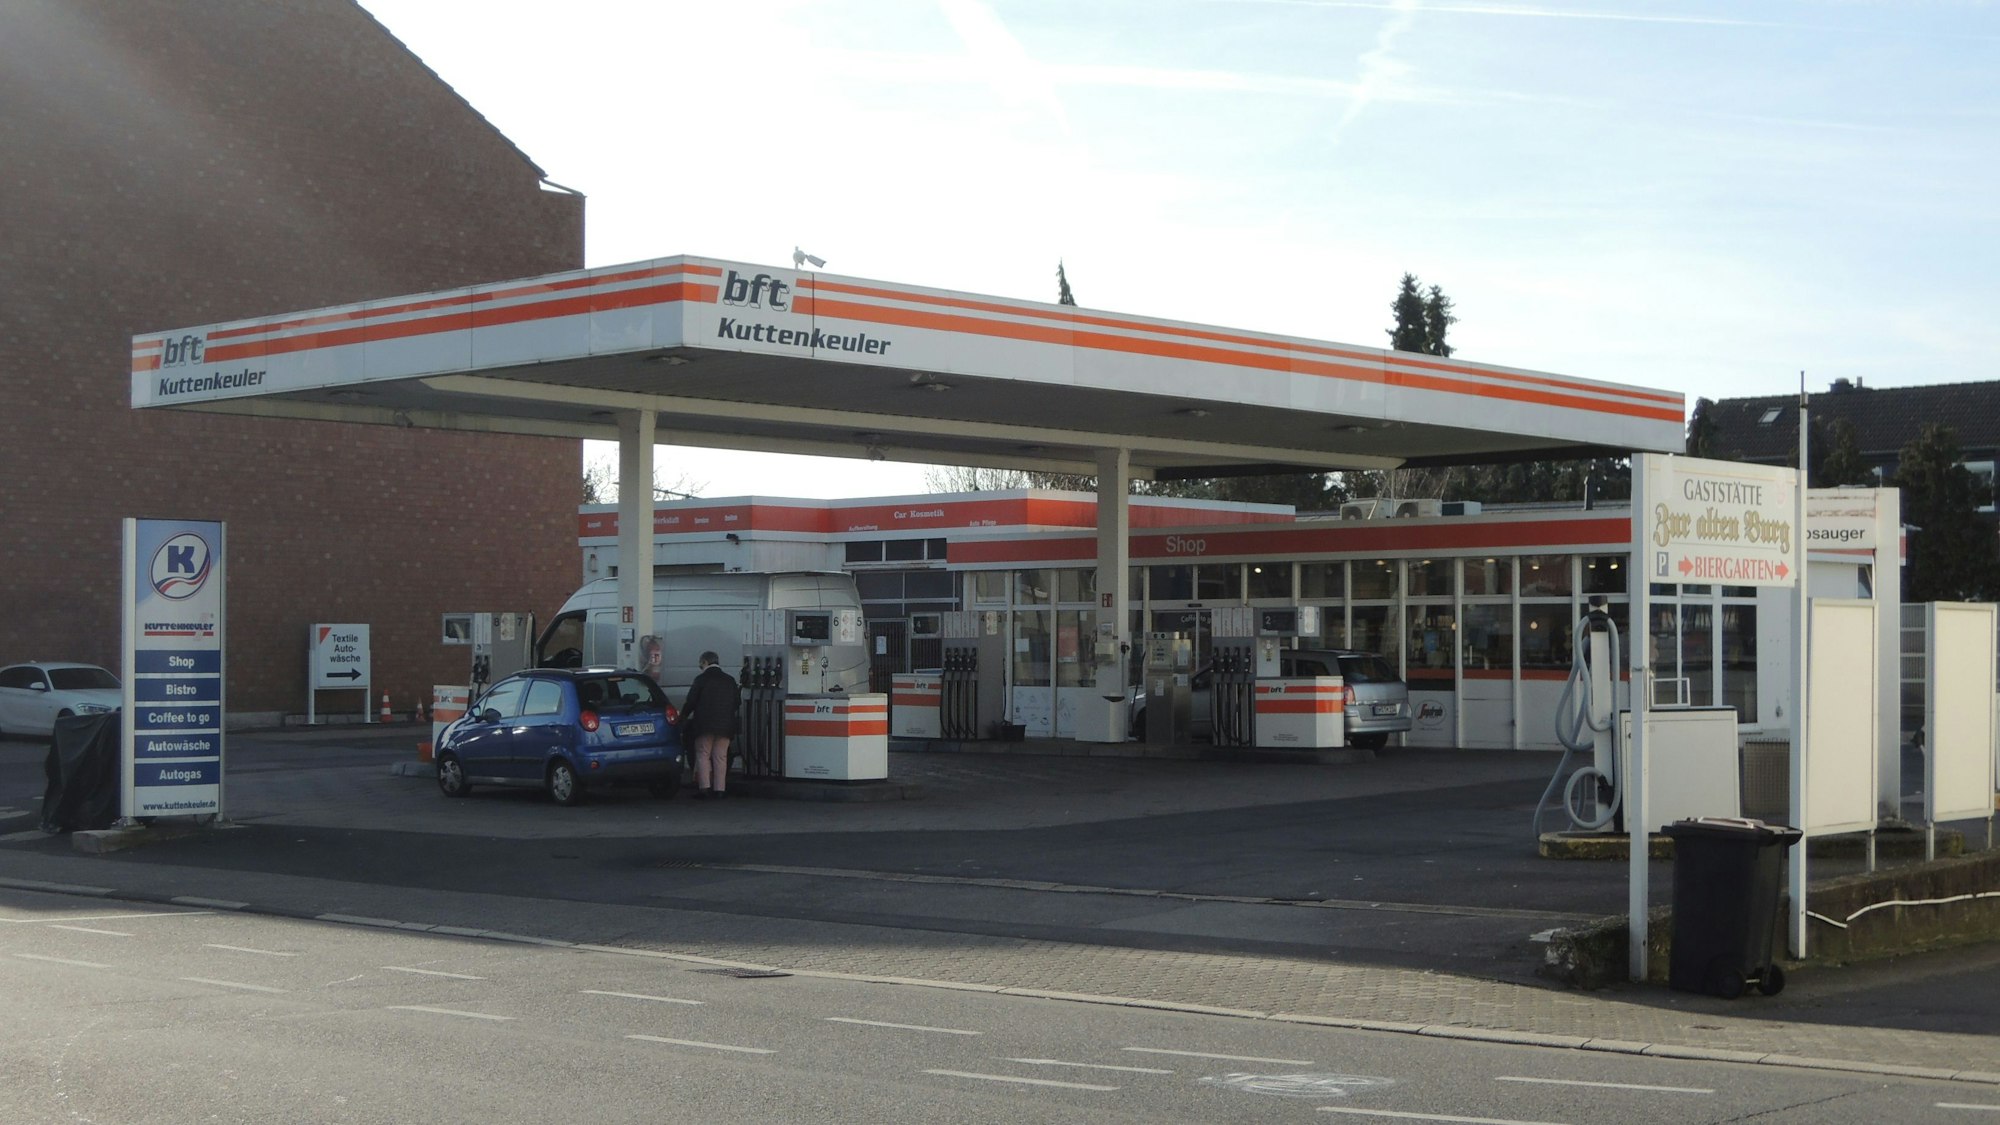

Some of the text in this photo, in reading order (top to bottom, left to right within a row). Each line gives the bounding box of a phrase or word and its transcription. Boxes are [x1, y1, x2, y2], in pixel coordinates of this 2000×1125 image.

[722, 270, 790, 312] bft
[717, 316, 892, 355] Kuttenkeuler
[162, 334, 204, 368] bft
[158, 368, 267, 397] Kuttenkeuler
[1683, 478, 1763, 506] GASTSTÄTTE
[894, 509, 945, 519] Car Kosmetik
[1652, 502, 1791, 554] Zur alten Burg
[1165, 535, 1206, 556] Shop
[167, 545, 196, 574] K
[1694, 555, 1775, 581] BIERGARTEN
[493, 618, 500, 627] 8
[516, 617, 524, 626] 7
[833, 616, 840, 627] 6
[856, 616, 863, 627] 5
[1265, 615, 1271, 625] 2
[332, 634, 359, 643] Textile
[334, 644, 357, 653] Auto-
[168, 655, 195, 669] Shop
[329, 654, 361, 664] wäsche
[165, 683, 197, 696] Bistro
[1269, 686, 1283, 695] bft
[816, 705, 831, 714] bft
[148, 711, 211, 726] Coffee to go
[147, 739, 211, 753] Autowäsche
[159, 768, 202, 782] Autogas
[142, 800, 217, 813] www.kuttenkeuler.de
